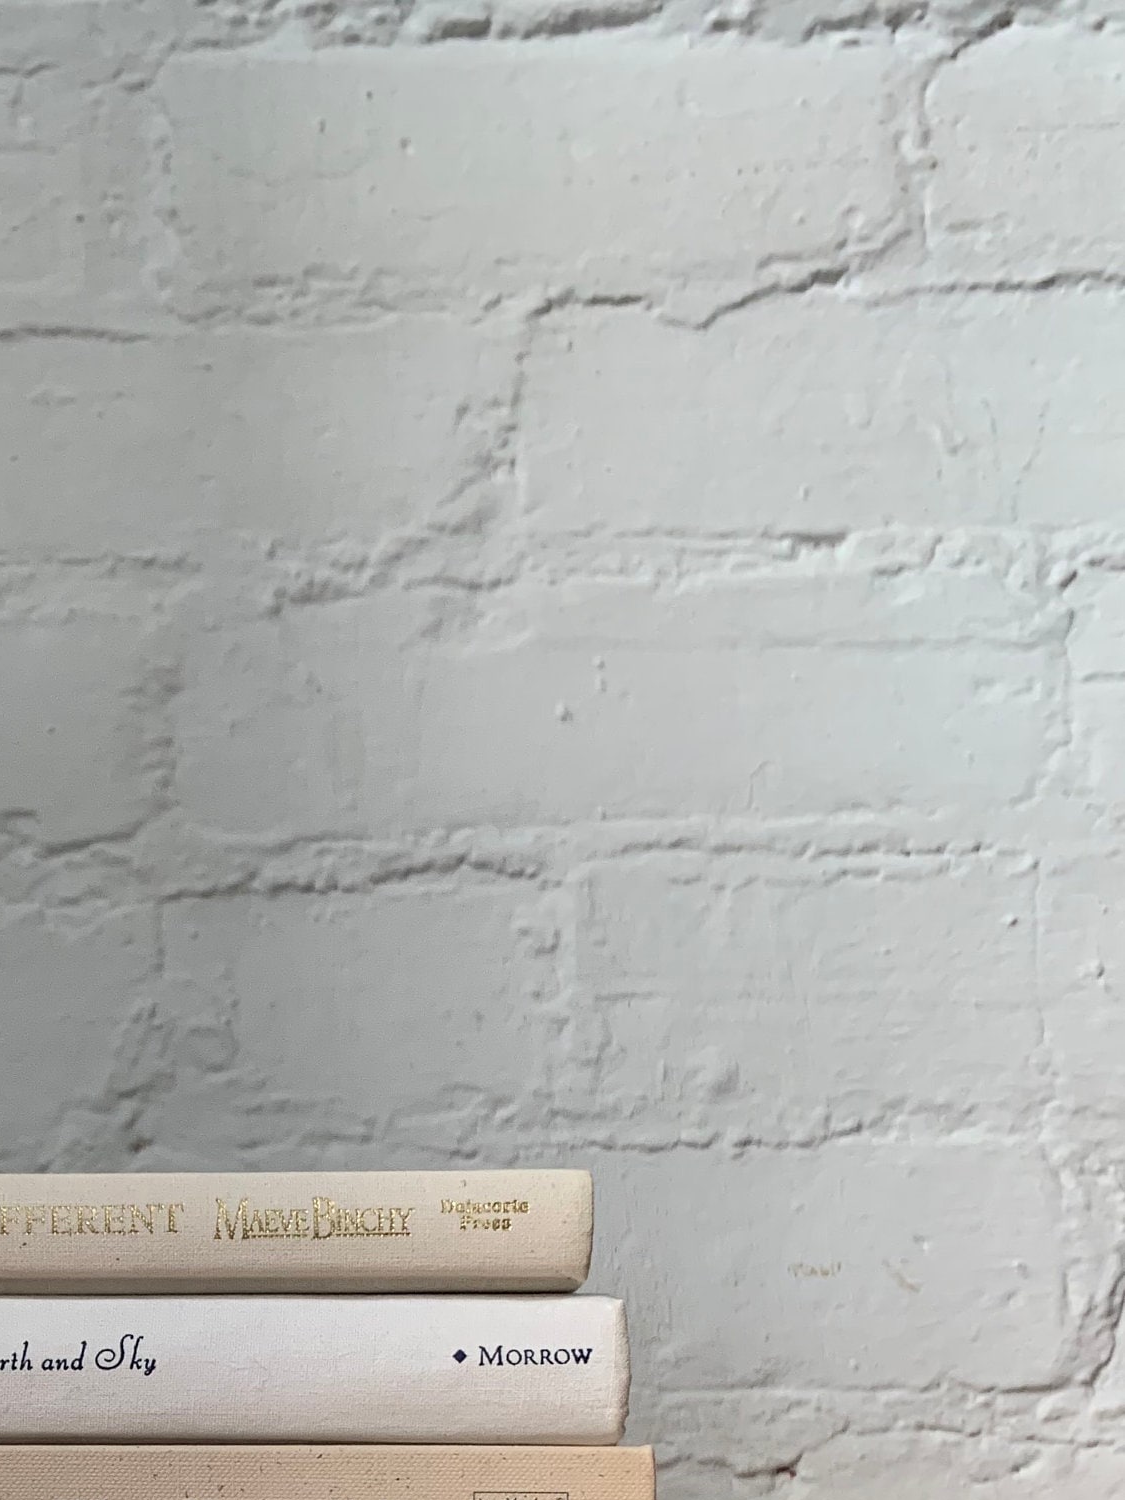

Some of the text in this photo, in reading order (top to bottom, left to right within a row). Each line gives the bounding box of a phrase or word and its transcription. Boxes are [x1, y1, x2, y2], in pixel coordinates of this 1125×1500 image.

[213, 1196, 416, 1241] MAEVE BINCHY
[440, 1199, 530, 1214] Delacorte
[41, 1341, 88, 1372] and
[95, 1334, 158, 1377] Sky
[478, 1345, 594, 1367] MORROW
